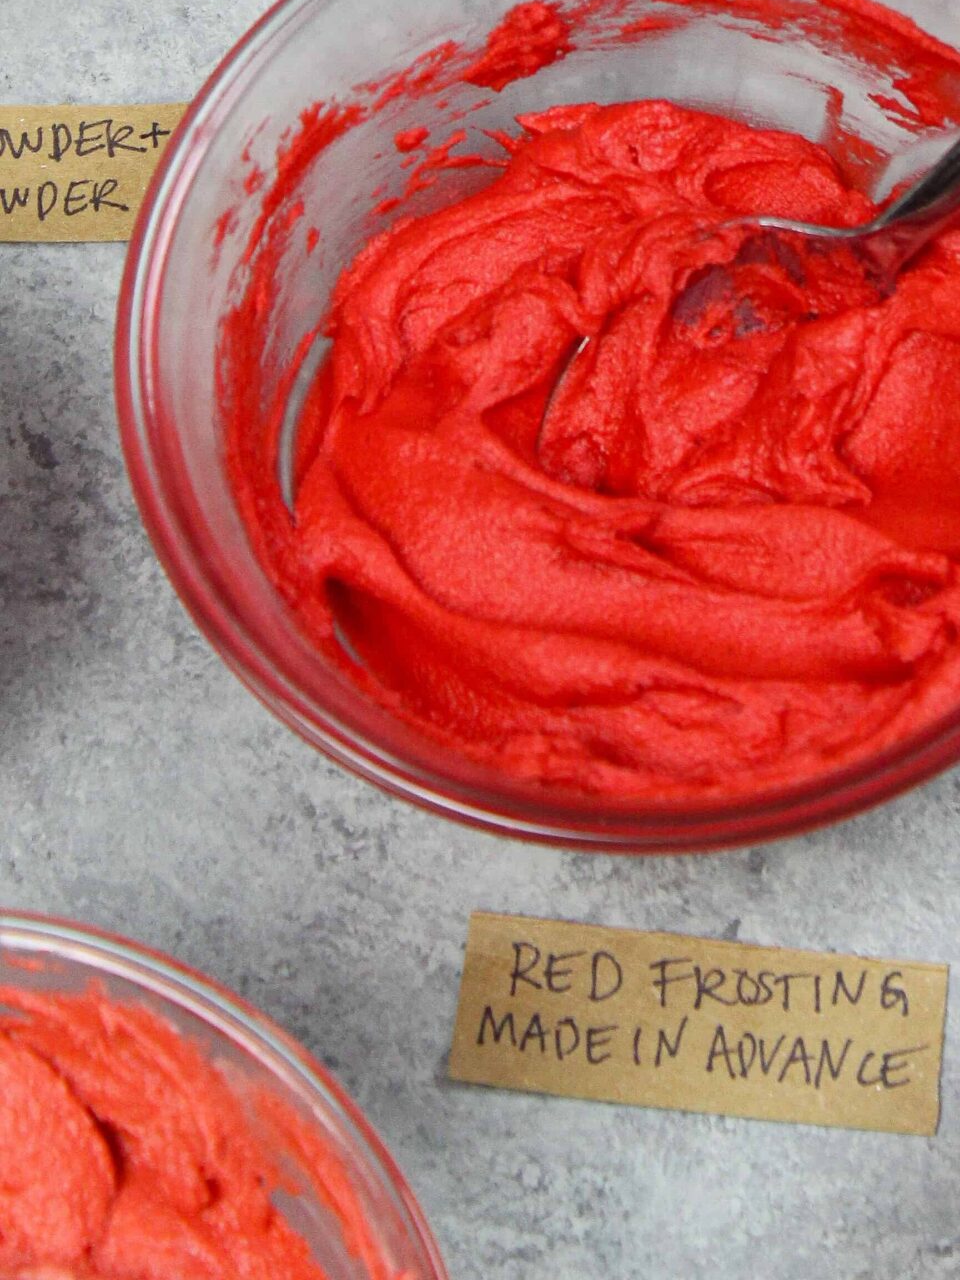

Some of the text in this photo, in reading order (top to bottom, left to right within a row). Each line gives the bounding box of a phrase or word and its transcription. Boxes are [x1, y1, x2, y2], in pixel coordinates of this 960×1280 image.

[510, 941, 910, 1018] RED FROSTING
[475, 1005, 931, 1089] MADE IN ADVANCE
